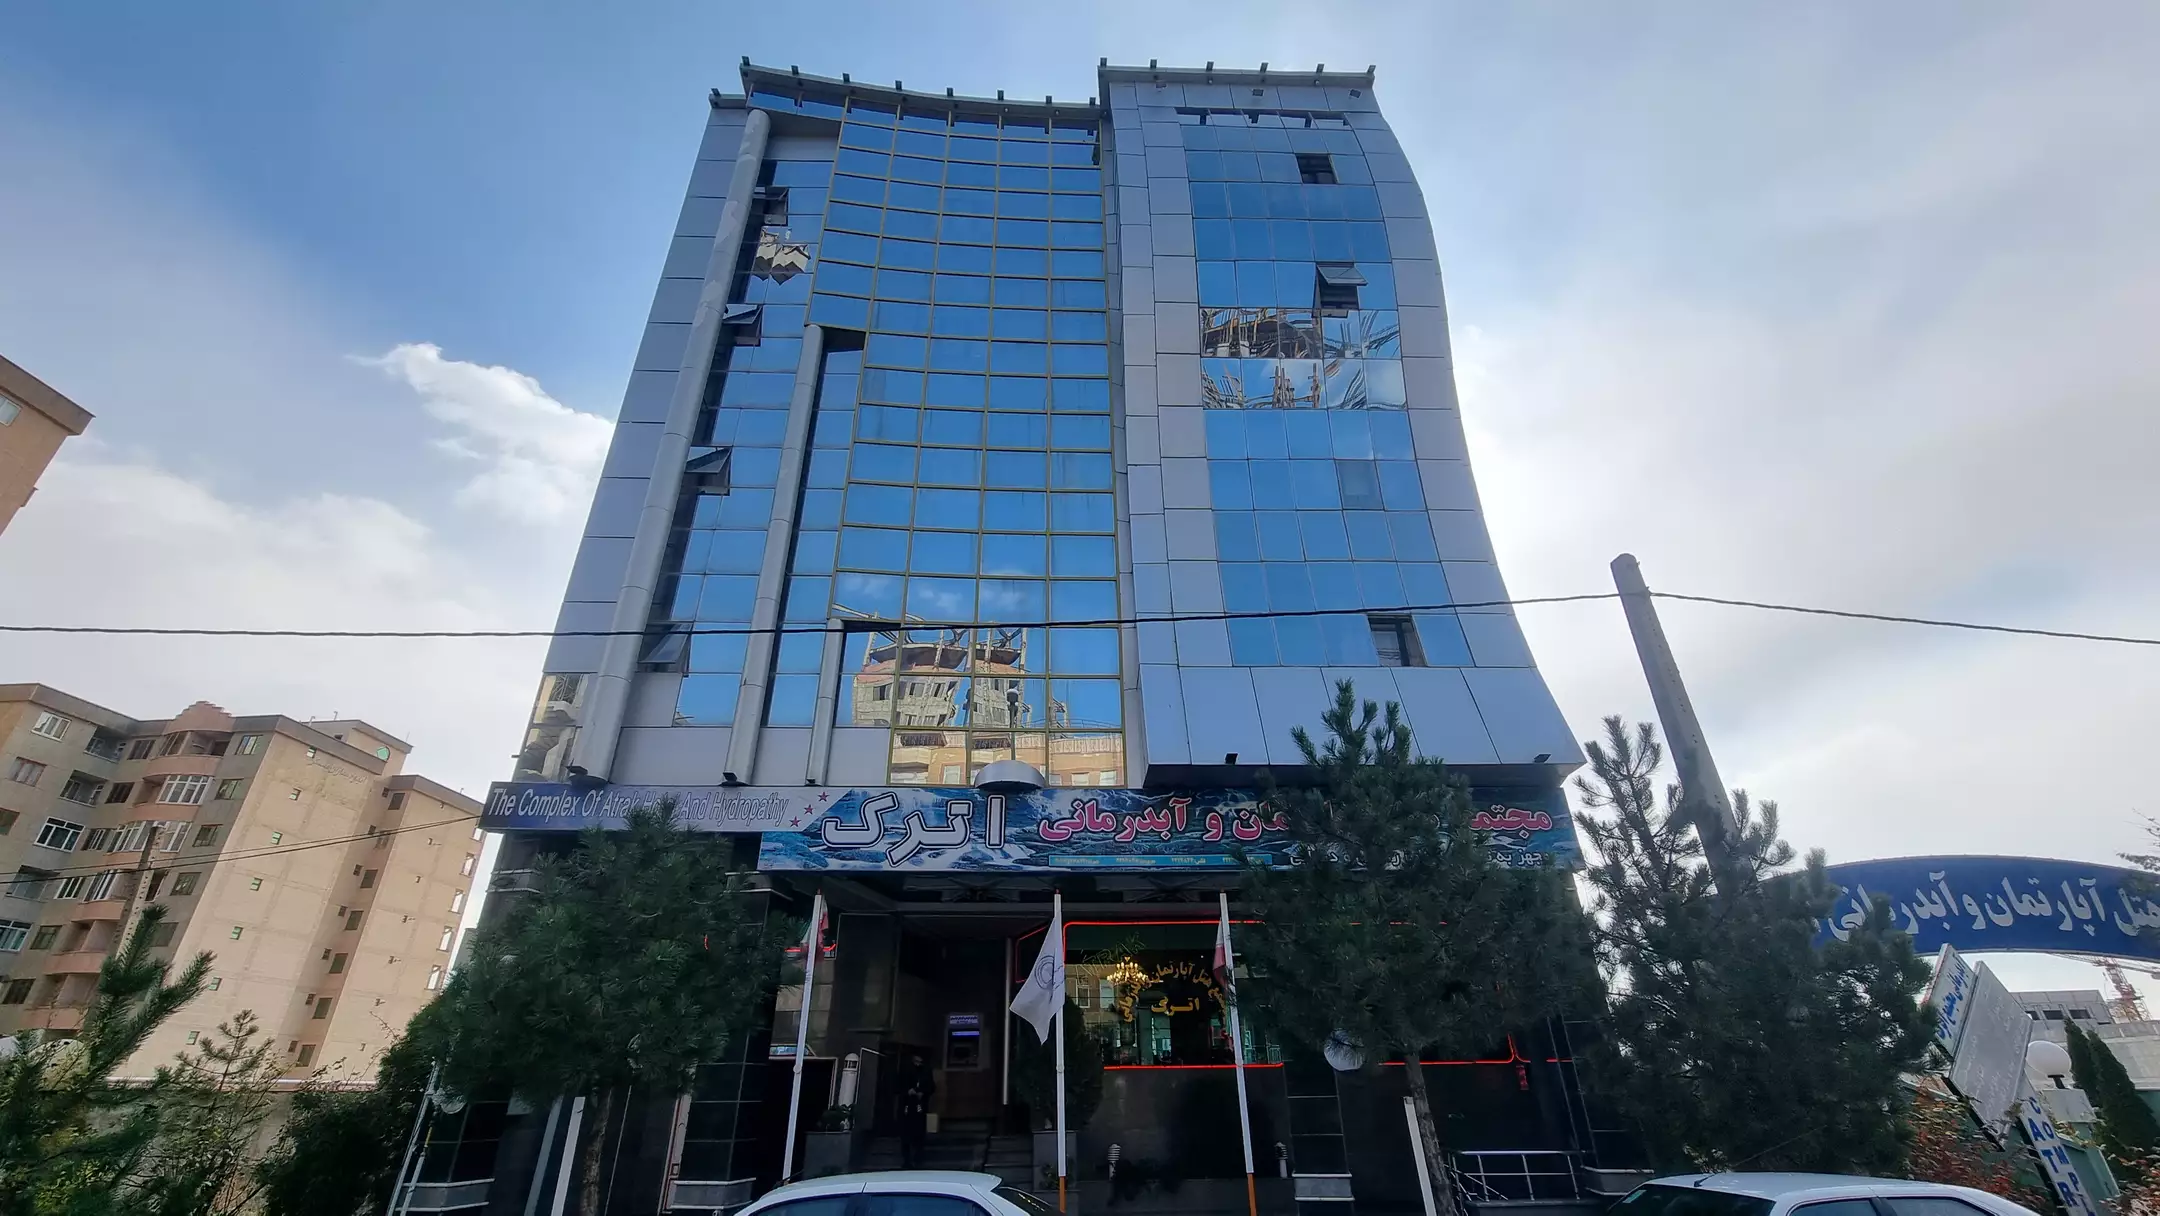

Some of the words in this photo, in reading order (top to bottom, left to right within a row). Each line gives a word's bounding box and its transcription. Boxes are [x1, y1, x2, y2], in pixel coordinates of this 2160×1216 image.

[488, 788, 515, 816] The
[517, 789, 577, 822] Complex
[581, 789, 601, 818] Of
[599, 790, 643, 818] Atrak
[679, 792, 712, 819] And
[709, 792, 789, 827] Hydropathy
[1039, 797, 1192, 842] آبدرمانی
[1469, 804, 1553, 839] مجتم
[821, 792, 1006, 868] اترک
[1203, 812, 1223, 842] و
[1962, 893, 1987, 930] و
[1985, 876, 2106, 937] آپارتمان
[1151, 996, 1200, 1017] اترک
